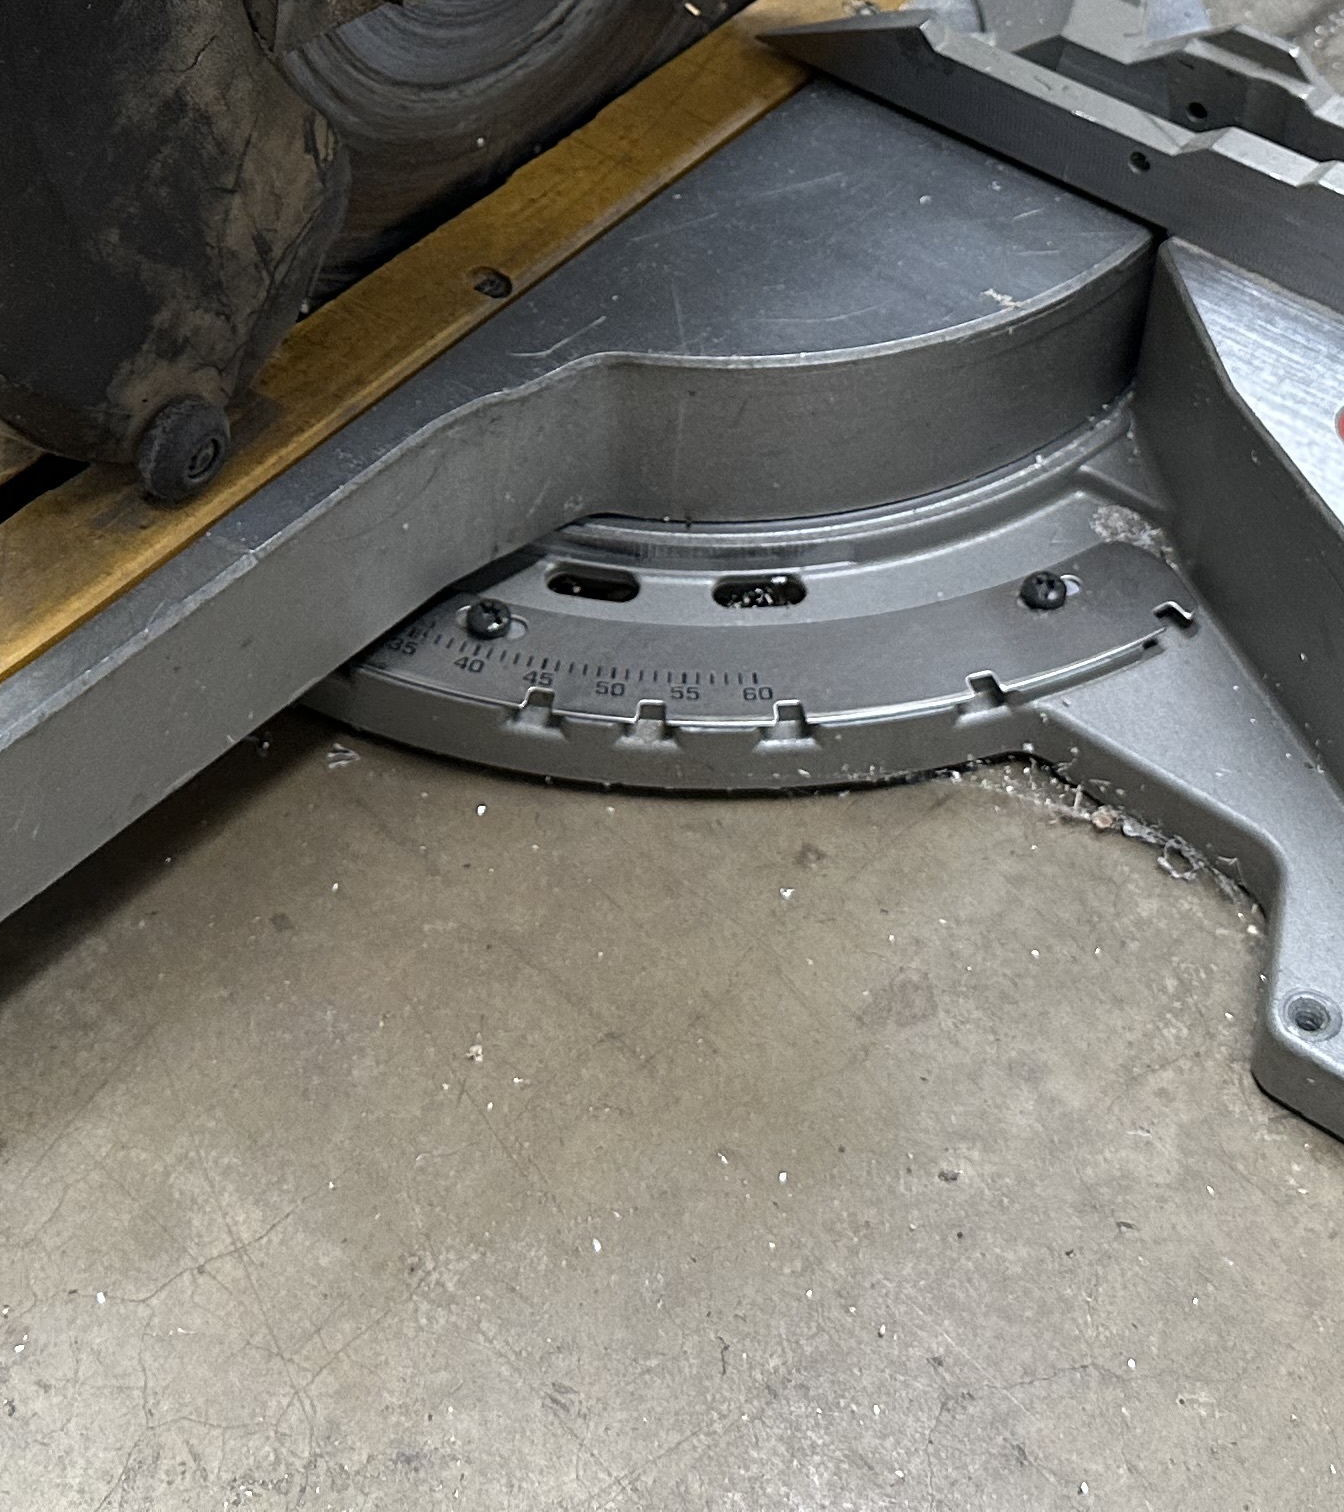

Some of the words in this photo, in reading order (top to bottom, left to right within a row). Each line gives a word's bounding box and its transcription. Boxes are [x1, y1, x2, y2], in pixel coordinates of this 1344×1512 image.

[387, 639, 418, 656] 35
[454, 656, 485, 673] 40
[523, 670, 553, 686] 45
[595, 681, 626, 697] 50
[670, 686, 700, 701] 55
[743, 687, 773, 700] 60
